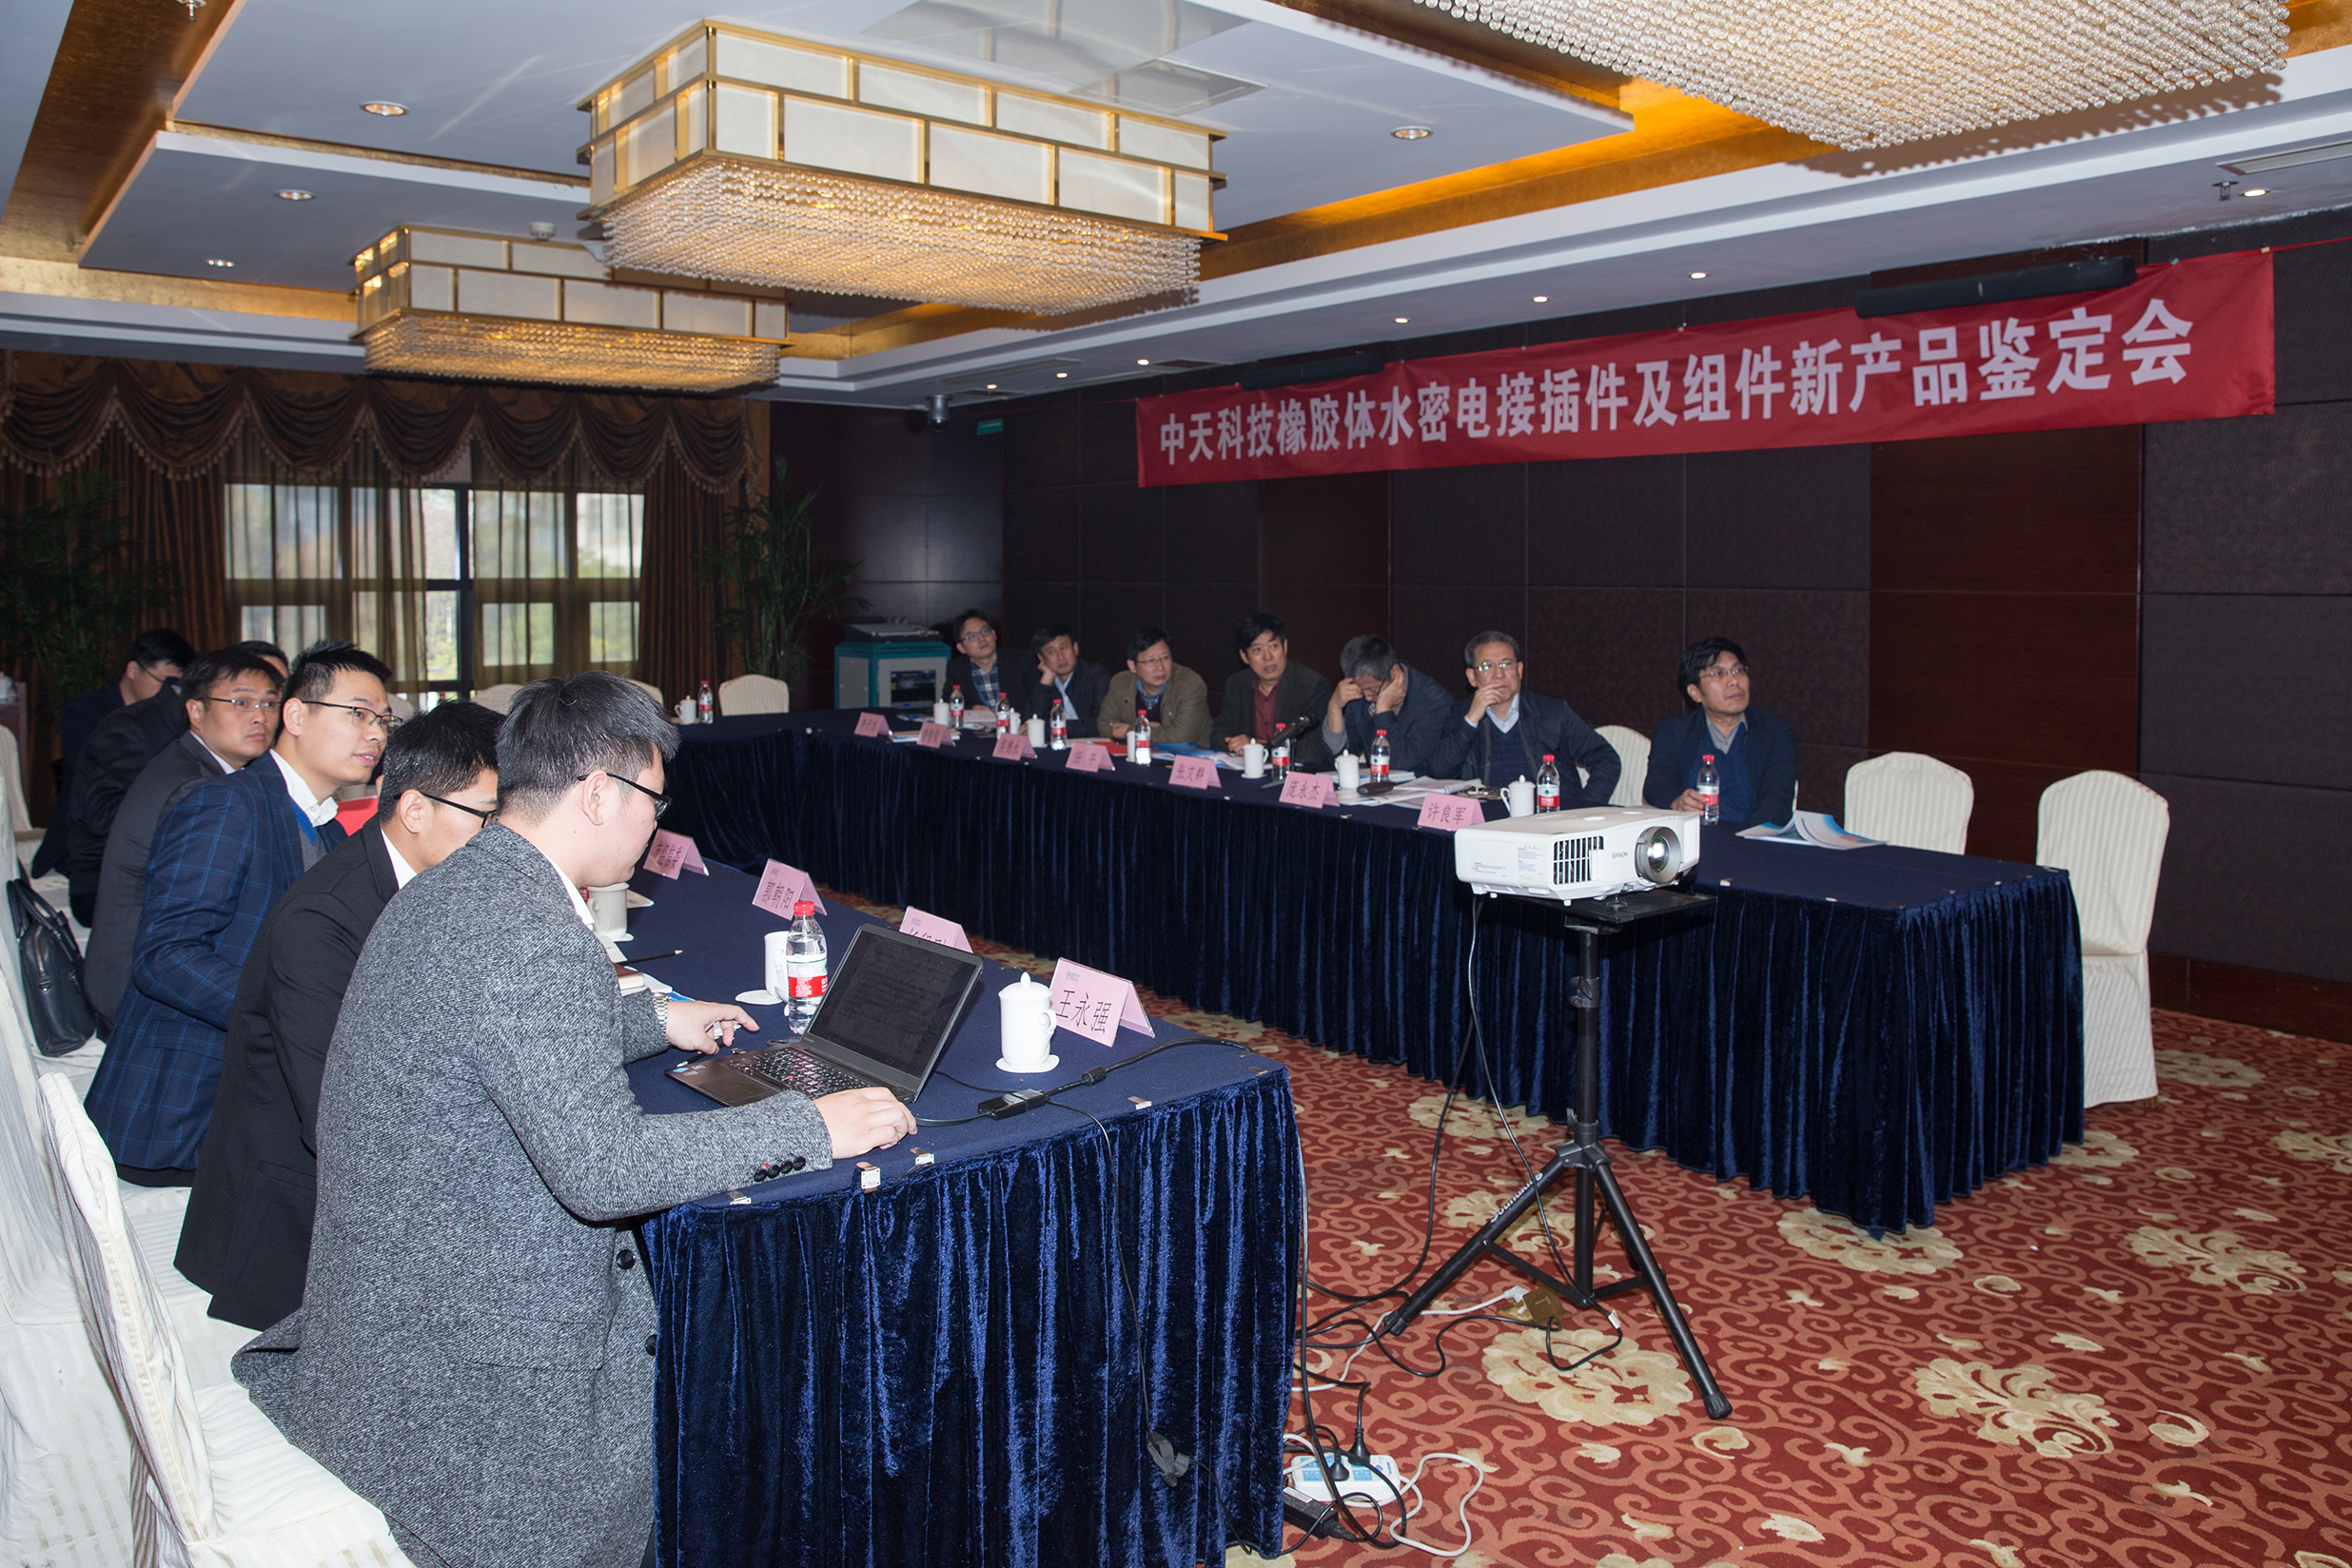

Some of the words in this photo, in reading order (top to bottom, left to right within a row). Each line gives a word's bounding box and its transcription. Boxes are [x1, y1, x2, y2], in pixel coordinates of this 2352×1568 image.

[1160, 298, 2193, 465] 中天科技橡胶体水密电接插件及组件新产品鉴定会
[1427, 802, 1466, 825] 许良军
[1056, 990, 1111, 1034] 王永强
